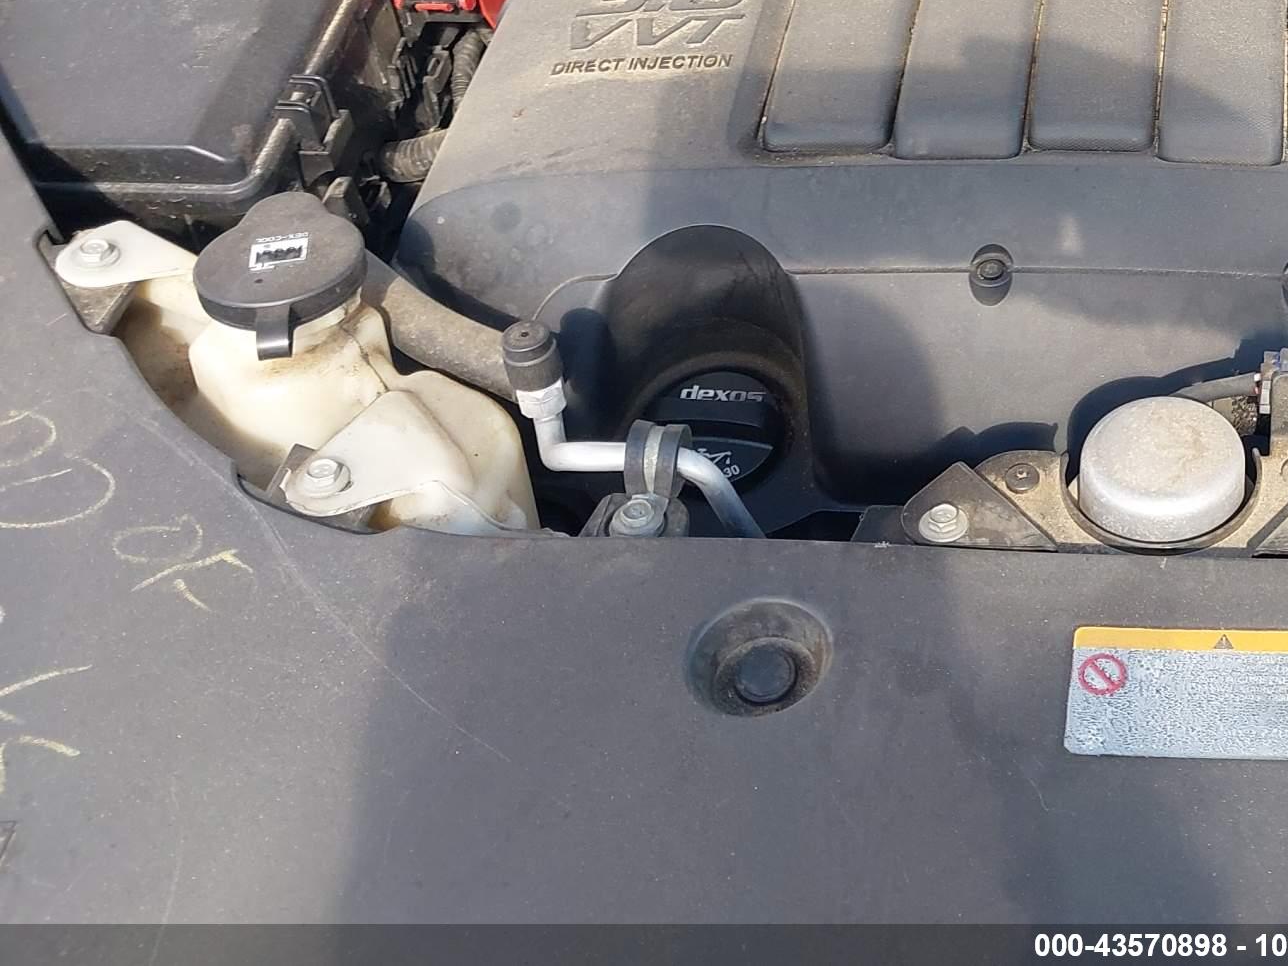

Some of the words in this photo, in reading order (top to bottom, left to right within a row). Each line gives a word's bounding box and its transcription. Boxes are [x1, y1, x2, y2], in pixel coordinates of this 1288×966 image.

[570, 14, 745, 50] VVT
[551, 57, 625, 75] DIRECT
[628, 54, 733, 72] INJECTION
[680, 385, 766, 402] dexos
